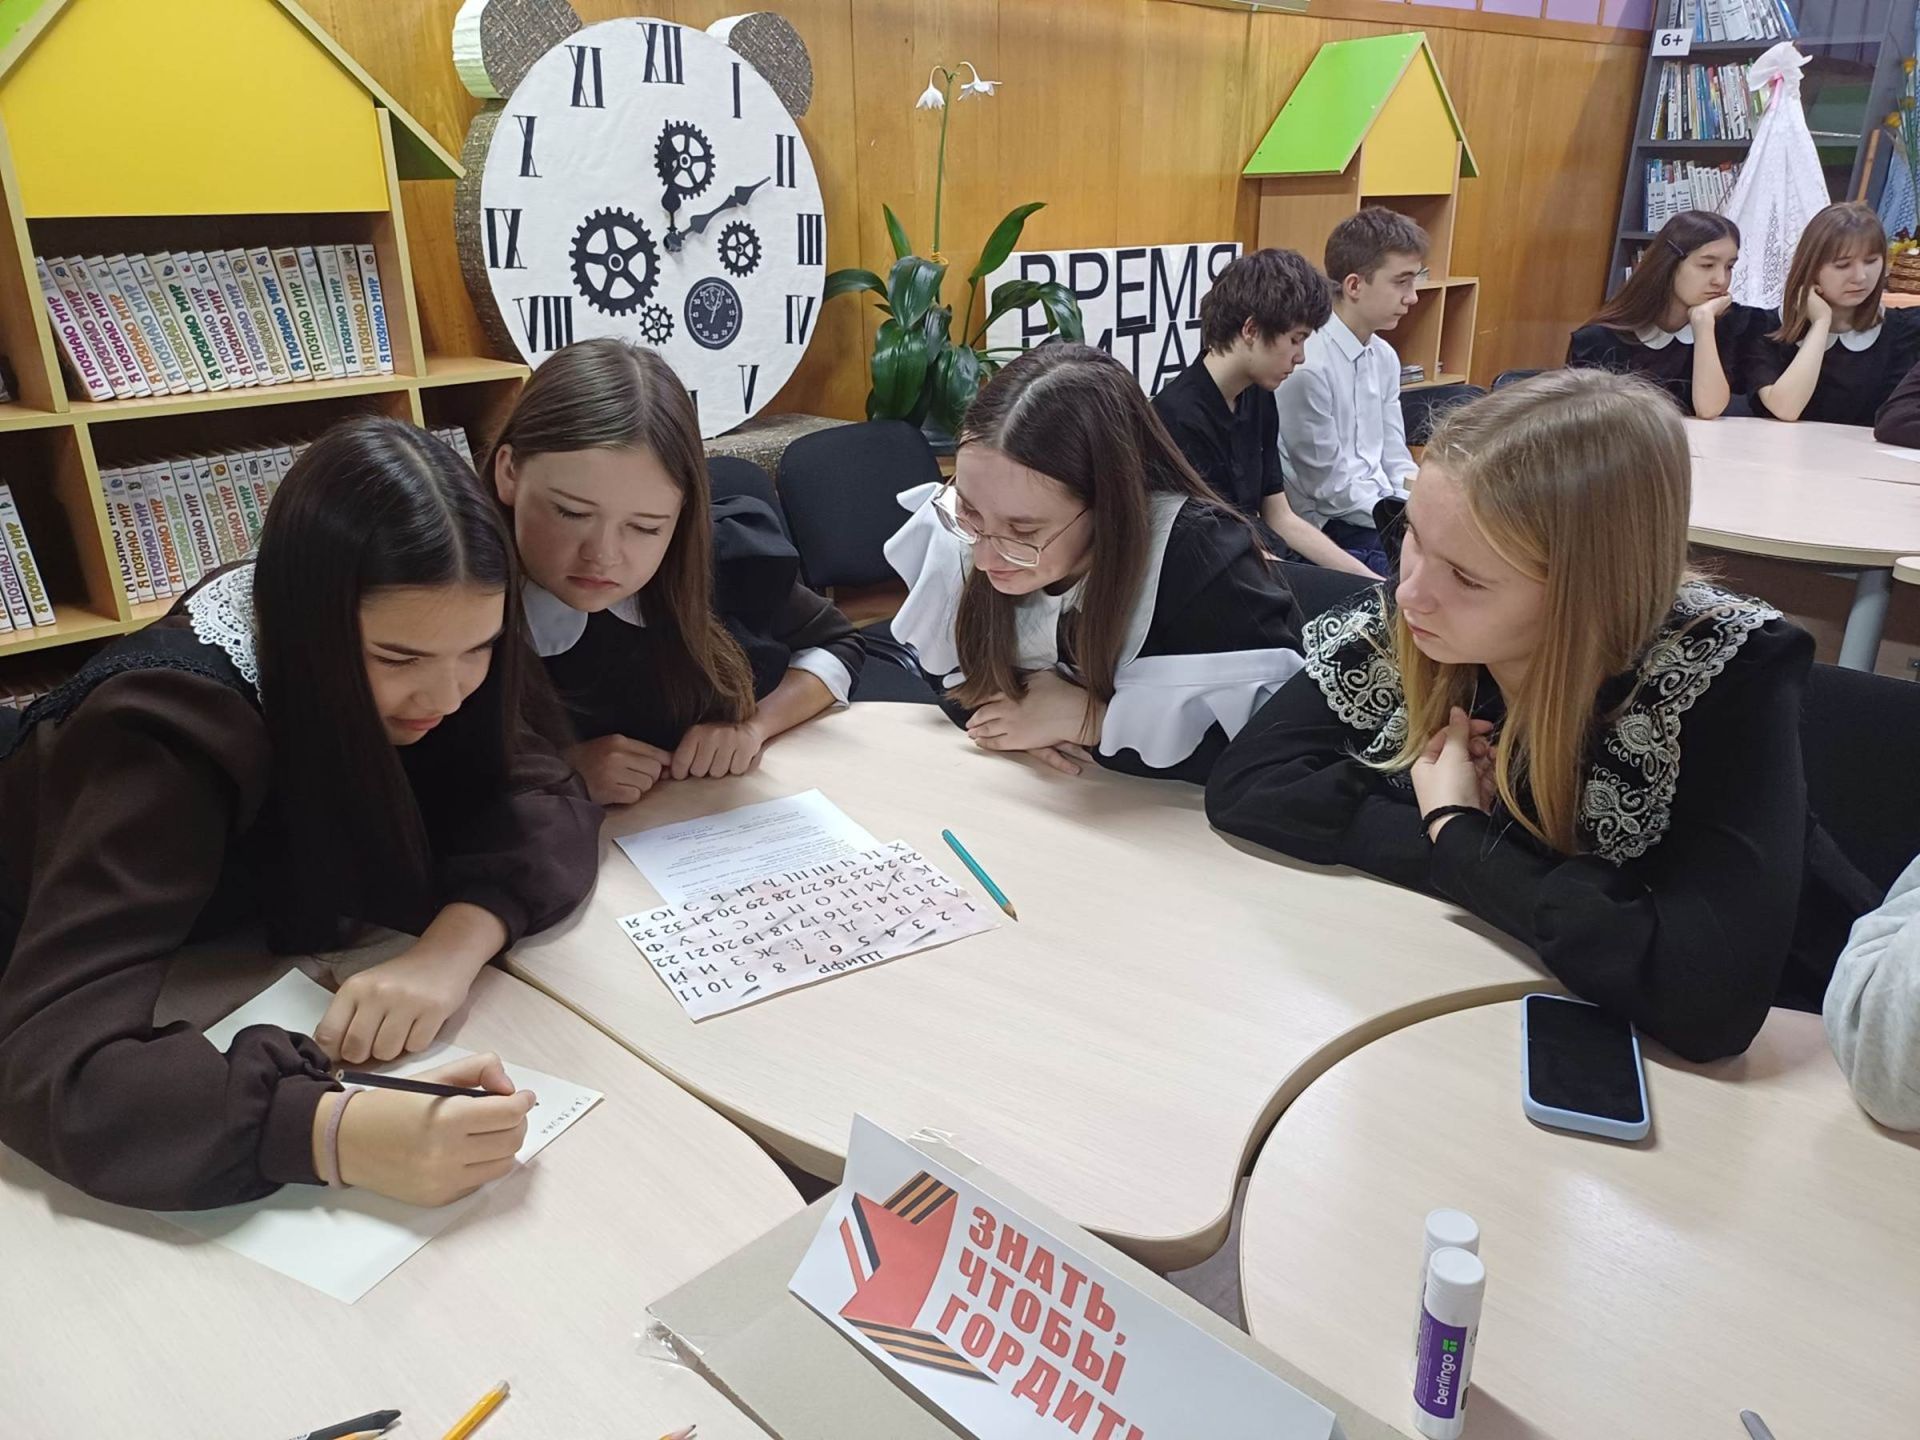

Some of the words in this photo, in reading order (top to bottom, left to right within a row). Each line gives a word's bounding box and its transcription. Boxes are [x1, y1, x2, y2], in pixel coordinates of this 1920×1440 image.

[1661, 33, 1684, 47] 6+
[636, 22, 685, 84] XII
[565, 45, 605, 108] XI
[513, 115, 542, 177] X
[775, 134, 797, 188] II
[484, 208, 527, 269] IX
[797, 213, 823, 265] III
[124, 284, 148, 312] МИР
[169, 284, 191, 313] МИР
[191, 288, 210, 312] МИР
[225, 284, 244, 309] МИР
[262, 277, 281, 304] МИР
[290, 282, 307, 308] МИР
[330, 278, 344, 303] МИР
[348, 275, 362, 300] МИР
[368, 277, 382, 302] МИР
[48, 296, 70, 323] МИР
[66, 290, 90, 318] МИР
[87, 292, 108, 318] МИР
[108, 293, 131, 320] МИР
[207, 289, 226, 314] МИР
[336, 306, 356, 354] ПОЗНАЮ
[353, 304, 373, 353] ПОЗНАЮ
[373, 305, 389, 352] ПОЗНАЮ
[513, 295, 574, 353] VIII
[785, 295, 816, 345] IV
[103, 320, 136, 372] ПОЗНАЮ
[141, 315, 175, 369] ПОЗНАЮ
[184, 315, 217, 368] ПОЗНАЮ
[204, 315, 232, 363] ПОЗНАЮ
[220, 317, 248, 365] ПОЗНАЮ
[238, 312, 264, 361] ПОЗНАЮ
[274, 307, 300, 360] ПОЗНАЮ
[299, 311, 323, 361] ПОЗНАЮ
[63, 325, 97, 377] ПОЗНАЮ
[83, 320, 119, 375] ПОЗНАЮ
[124, 322, 156, 372] ПОЗНАЮ
[738, 365, 760, 414] V
[185, 493, 202, 517] МИР
[220, 486, 236, 510] МИР
[239, 485, 254, 509] МИР
[117, 503, 134, 528] МИР
[134, 503, 151, 527] МИР
[150, 499, 166, 523] МИР
[6, 523, 26, 549] МИР
[192, 520, 214, 565] ПОЗНАЮ
[228, 512, 248, 557] ОЗНАЮ
[126, 531, 147, 577] ПОЗНАЮ
[142, 529, 164, 577] ПОЗНАЮ
[158, 526, 179, 572] ПОЗНАЮ
[18, 551, 44, 602] ПОЗНАЮ
[874, 860, 897, 871] 24
[900, 853, 922, 863] 23
[824, 876, 848, 887] 26
[850, 868, 872, 880] 25
[926, 876, 949, 887] 12
[772, 890, 796, 901] 28
[801, 883, 822, 894] 27
[877, 893, 899, 903] 14
[903, 884, 924, 895] 13
[718, 905, 741, 918] 30
[746, 898, 769, 909] 29
[824, 908, 847, 920] 16
[852, 901, 872, 912] 15
[936, 912, 951, 920] 2
[965, 903, 975, 912] 1
[660, 921, 685, 934] 32
[692, 913, 714, 925] 31
[770, 924, 793, 936] 18
[800, 917, 820, 928] 17
[912, 919, 925, 929] 3
[633, 929, 656, 941] 33
[742, 932, 764, 944] 19
[858, 936, 870, 946] 5
[885, 929, 896, 937] 4
[686, 948, 709, 960] 21
[712, 940, 738, 952] 20
[830, 945, 842, 955] 6
[653, 955, 679, 967] 22
[773, 962, 786, 973] 8
[804, 954, 816, 964] 7
[818, 951, 884, 974] Шифр
[708, 978, 732, 992] 10
[745, 972, 757, 982] 9
[679, 987, 702, 1001] 11
[959, 1206, 1127, 1346] ЗНАТЬ,
[959, 1247, 1127, 1396] ЧТОБЫ
[1434, 1354, 1456, 1405] berlingo
